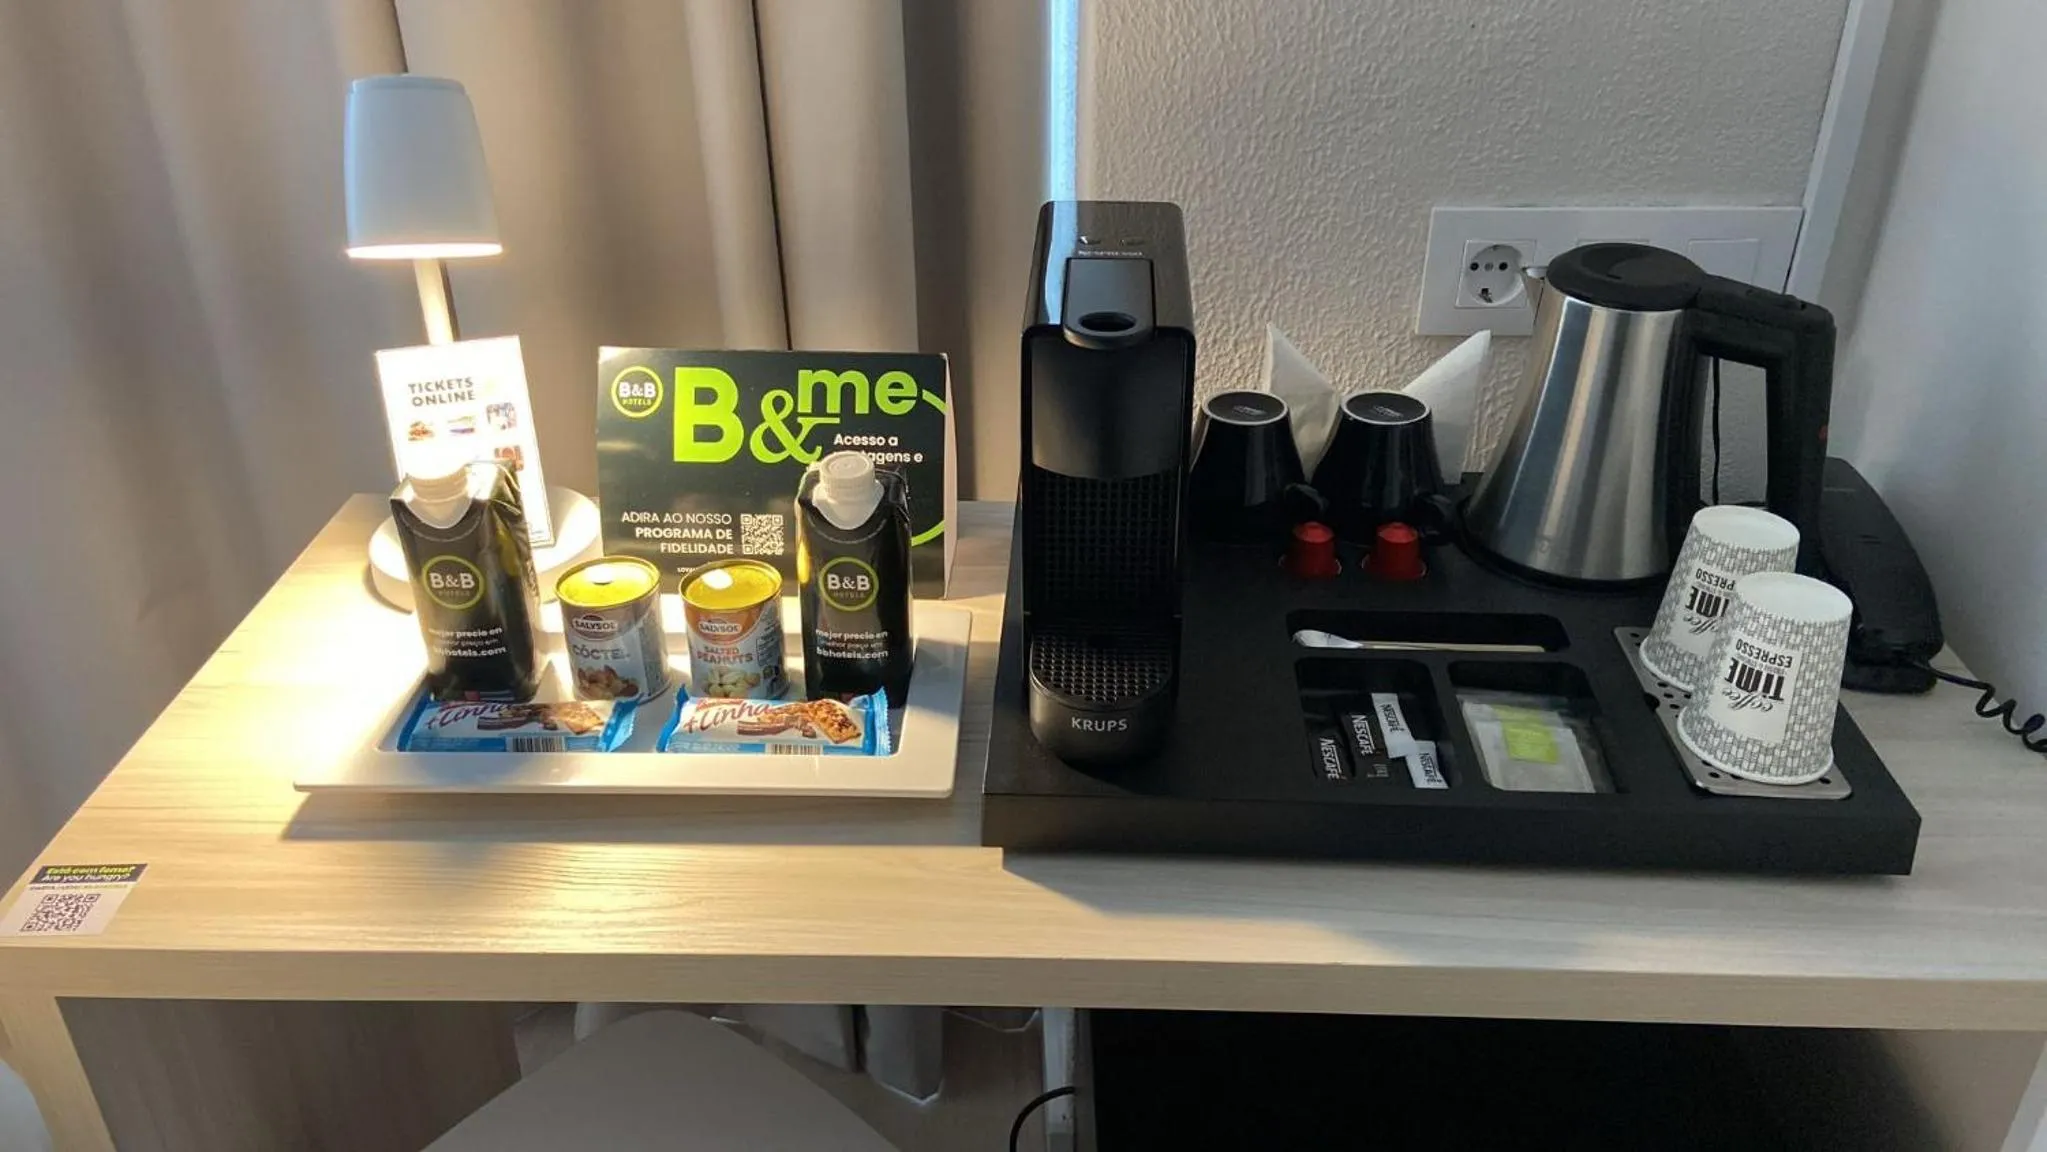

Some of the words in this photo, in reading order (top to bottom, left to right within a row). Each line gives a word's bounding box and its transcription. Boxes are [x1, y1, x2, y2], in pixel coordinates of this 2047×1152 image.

[407, 376, 474, 394] TICKETS
[618, 381, 656, 398] B&B
[411, 390, 476, 407] ONLINE
[833, 433, 886, 446] Acesso
[888, 436, 899, 446] a
[866, 451, 911, 465] agens
[913, 452, 924, 463] e
[621, 511, 660, 524] ADIRA
[663, 512, 684, 524] AO
[685, 513, 732, 525] NOSSO
[635, 527, 713, 540] PROGRAMA
[715, 529, 733, 540] DE
[660, 542, 734, 555] FIDELIDADE
[429, 572, 475, 589] B&B
[827, 574, 870, 591] B&B
[1696, 568, 1735, 590] PRESSO
[1685, 586, 1729, 618] IME
[843, 631, 874, 641] precio
[816, 646, 888, 659] bbhotels.com
[1736, 638, 1793, 669] ESPRESSO
[1071, 717, 1128, 732] KRUPS
